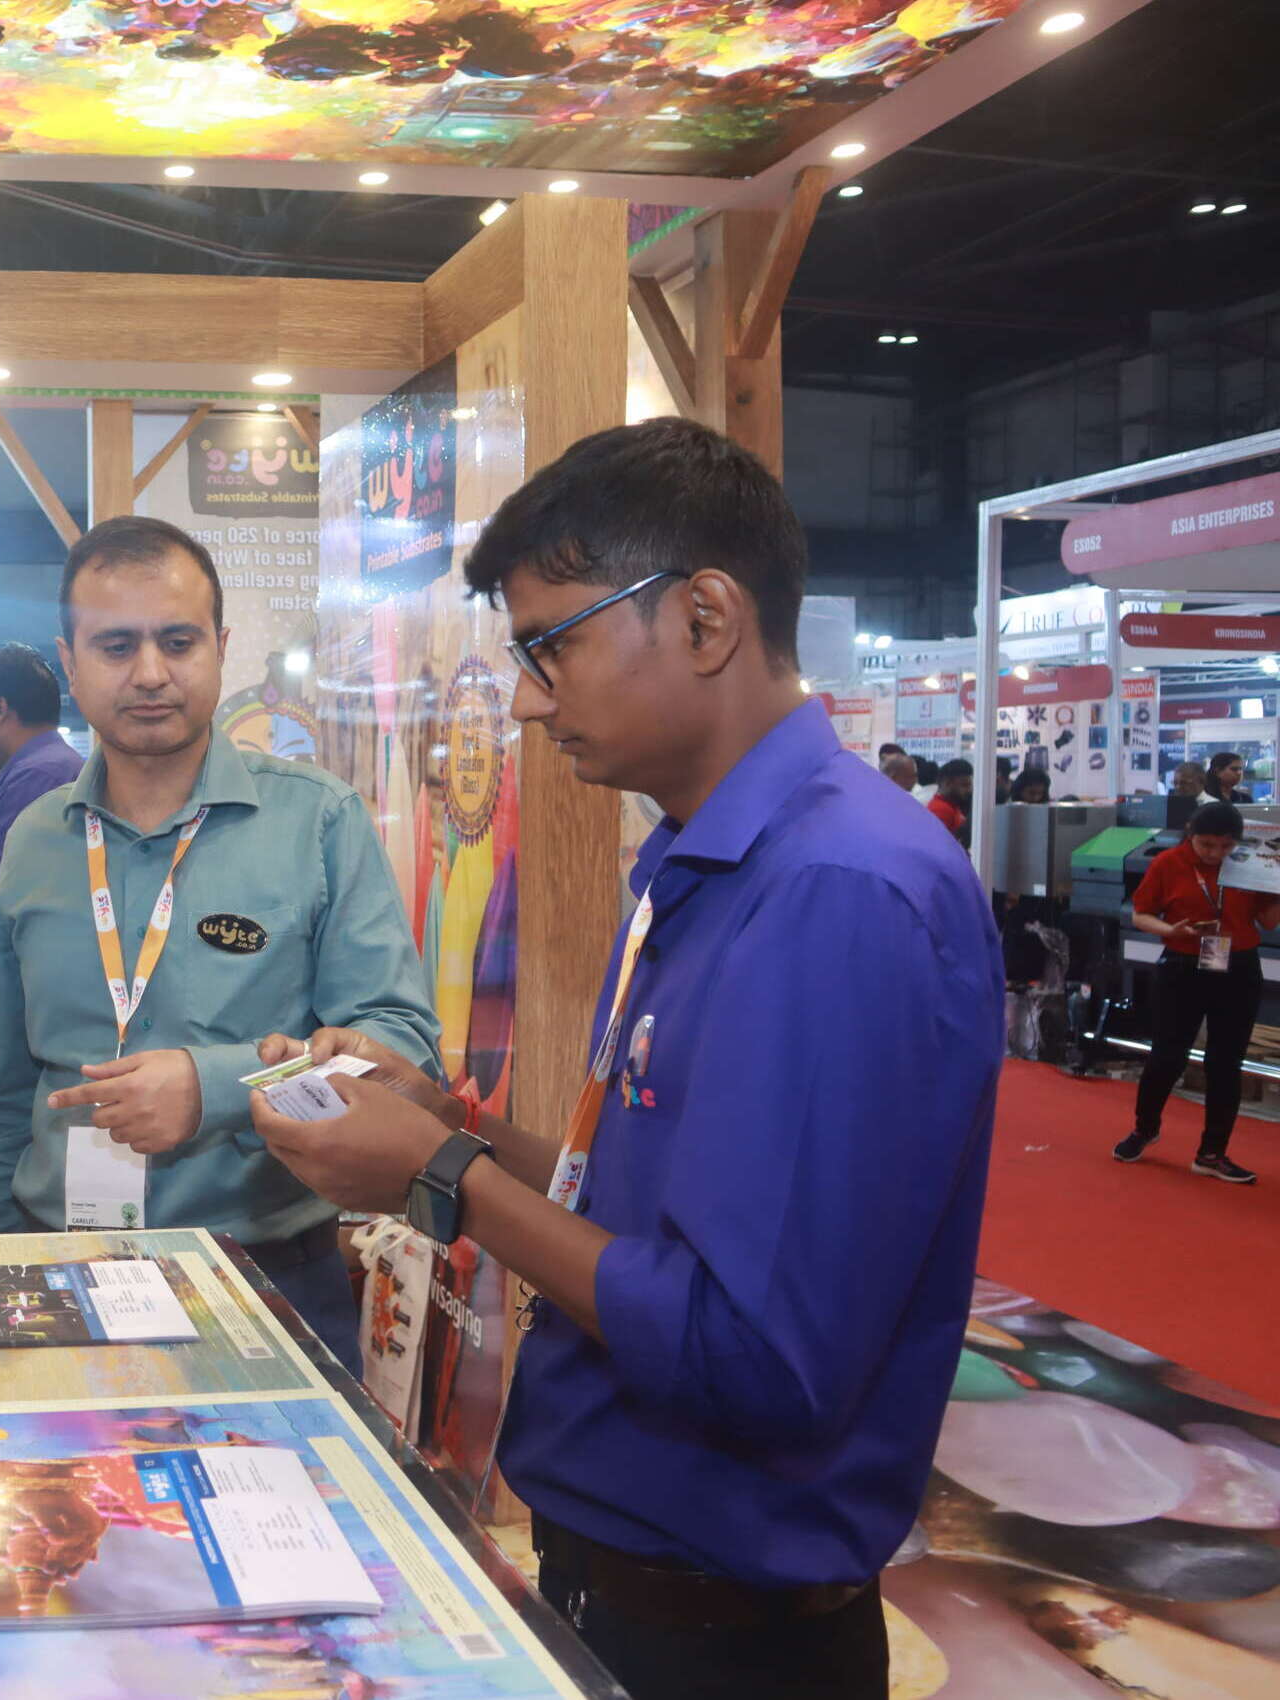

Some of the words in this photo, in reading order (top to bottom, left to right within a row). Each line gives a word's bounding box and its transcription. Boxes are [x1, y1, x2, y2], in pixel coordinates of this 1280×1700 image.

[1073, 535, 1103, 554] ES052
[1171, 517, 1196, 536] ASIA
[1198, 500, 1275, 531] ENTERPRISES
[202, 919, 259, 945] wyte
